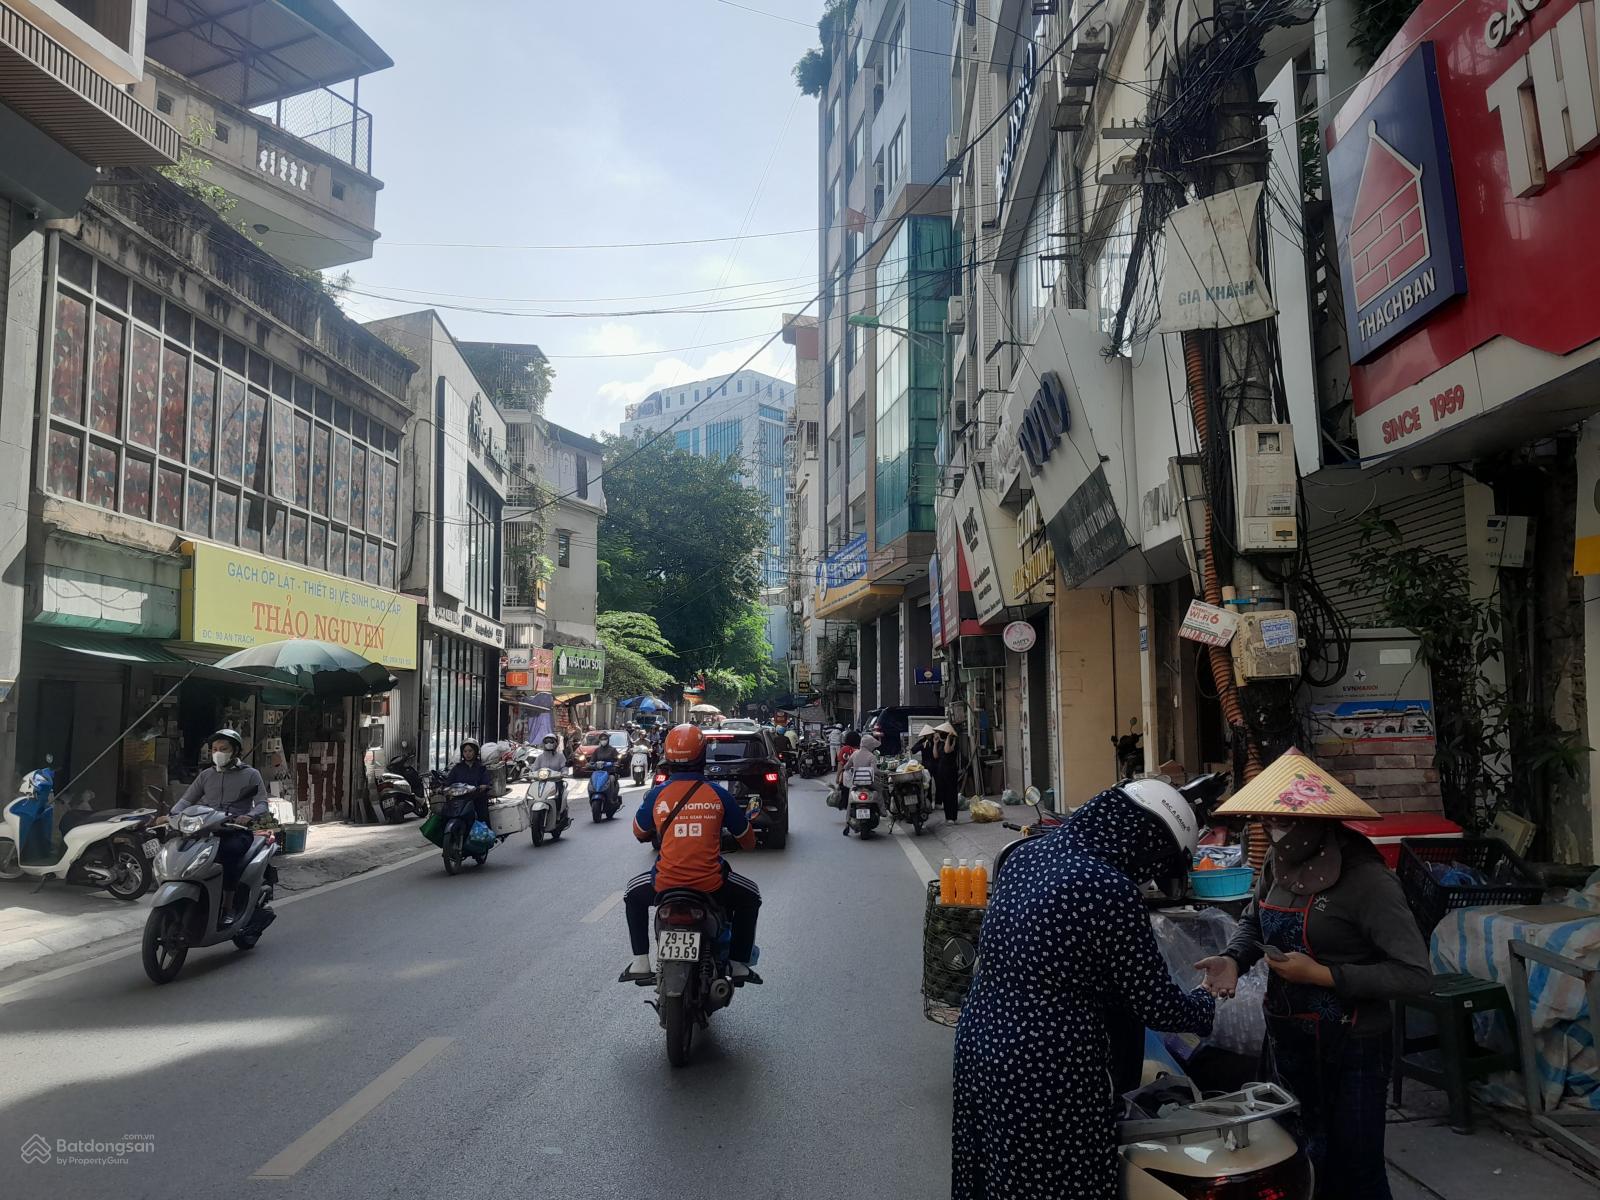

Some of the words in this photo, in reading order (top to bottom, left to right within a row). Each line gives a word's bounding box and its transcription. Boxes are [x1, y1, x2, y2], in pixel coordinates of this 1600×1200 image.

[1486, 0, 1600, 198] TH
[1178, 290, 1200, 305] GIA
[1206, 280, 1254, 301] KHÁNH
[1358, 267, 1436, 343] THACHBAN
[1381, 406, 1422, 445] SINCE
[1429, 384, 1465, 422] 1959
[228, 562, 258, 583] GẠCH
[261, 565, 275, 584] ỐP
[352, 592, 369, 608] SINH
[371, 598, 386, 612] CAO
[252, 594, 308, 638] THẢO
[314, 614, 384, 650] NGUYÊN
[660, 946, 697, 959] 413.69
[665, 932, 695, 947] 29-L5
